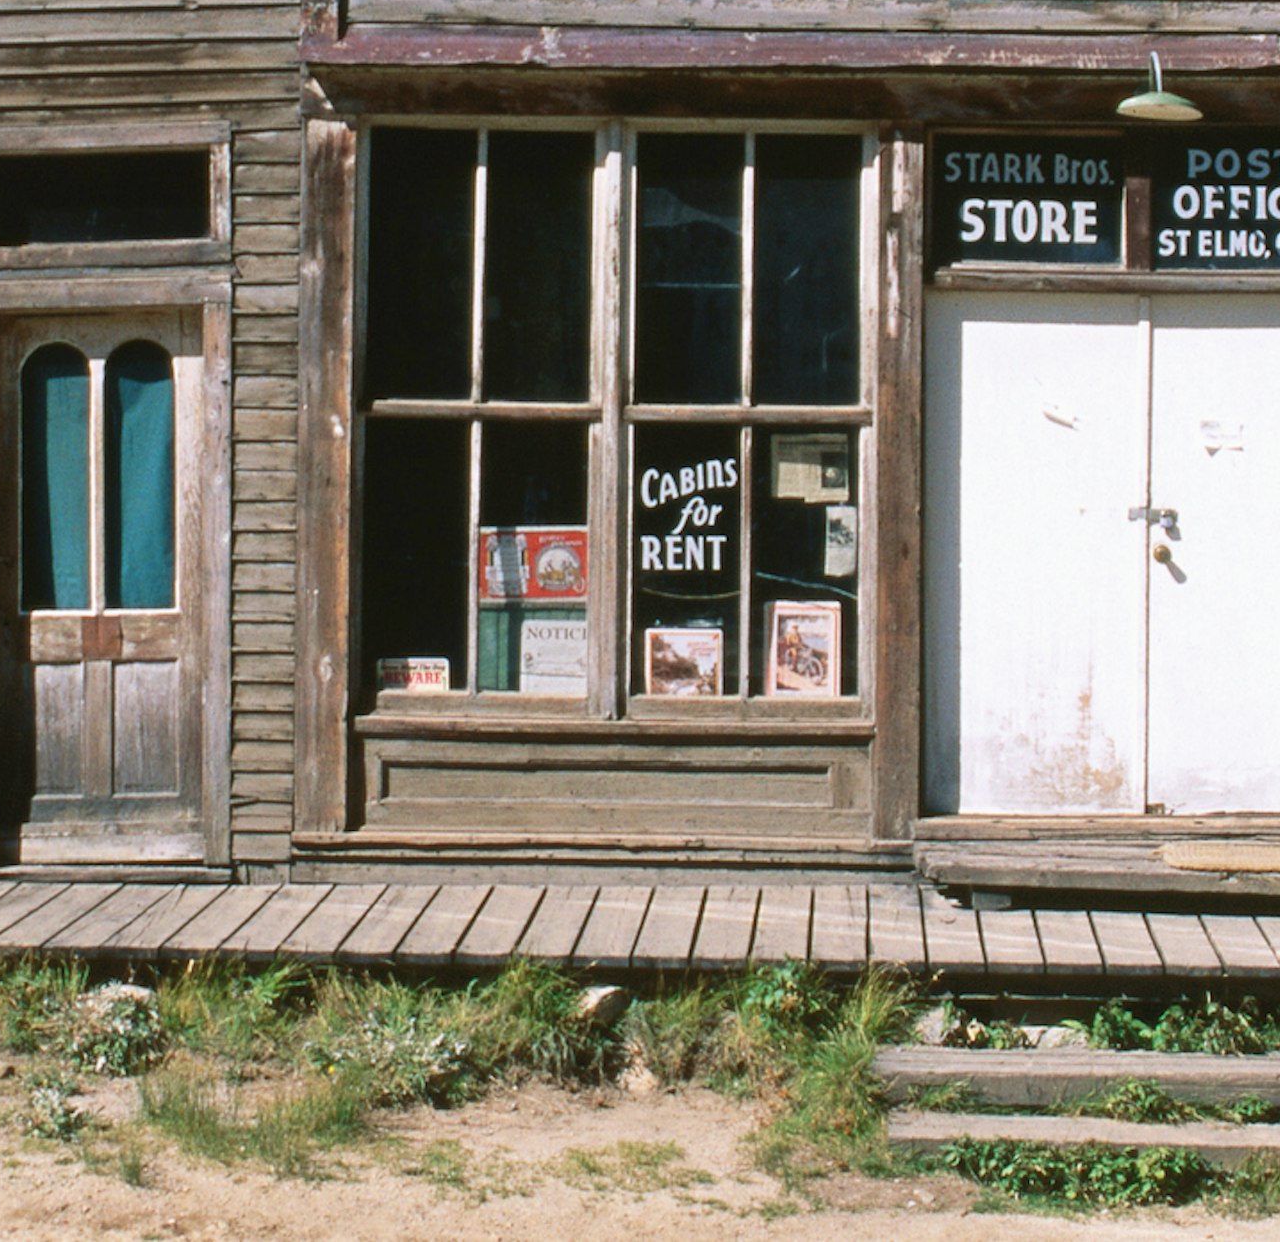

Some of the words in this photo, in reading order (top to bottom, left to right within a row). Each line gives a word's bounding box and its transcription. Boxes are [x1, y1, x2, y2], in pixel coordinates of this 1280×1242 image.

[944, 152, 1045, 184] STARK
[1053, 153, 1115, 185] Bros.
[960, 198, 1098, 243] STORE
[1158, 228, 1191, 257] ST
[1198, 230, 1271, 259] ELMO,
[641, 458, 738, 508] CABINS
[640, 535, 727, 571] RENT
[384, 671, 441, 684] BEWARE
